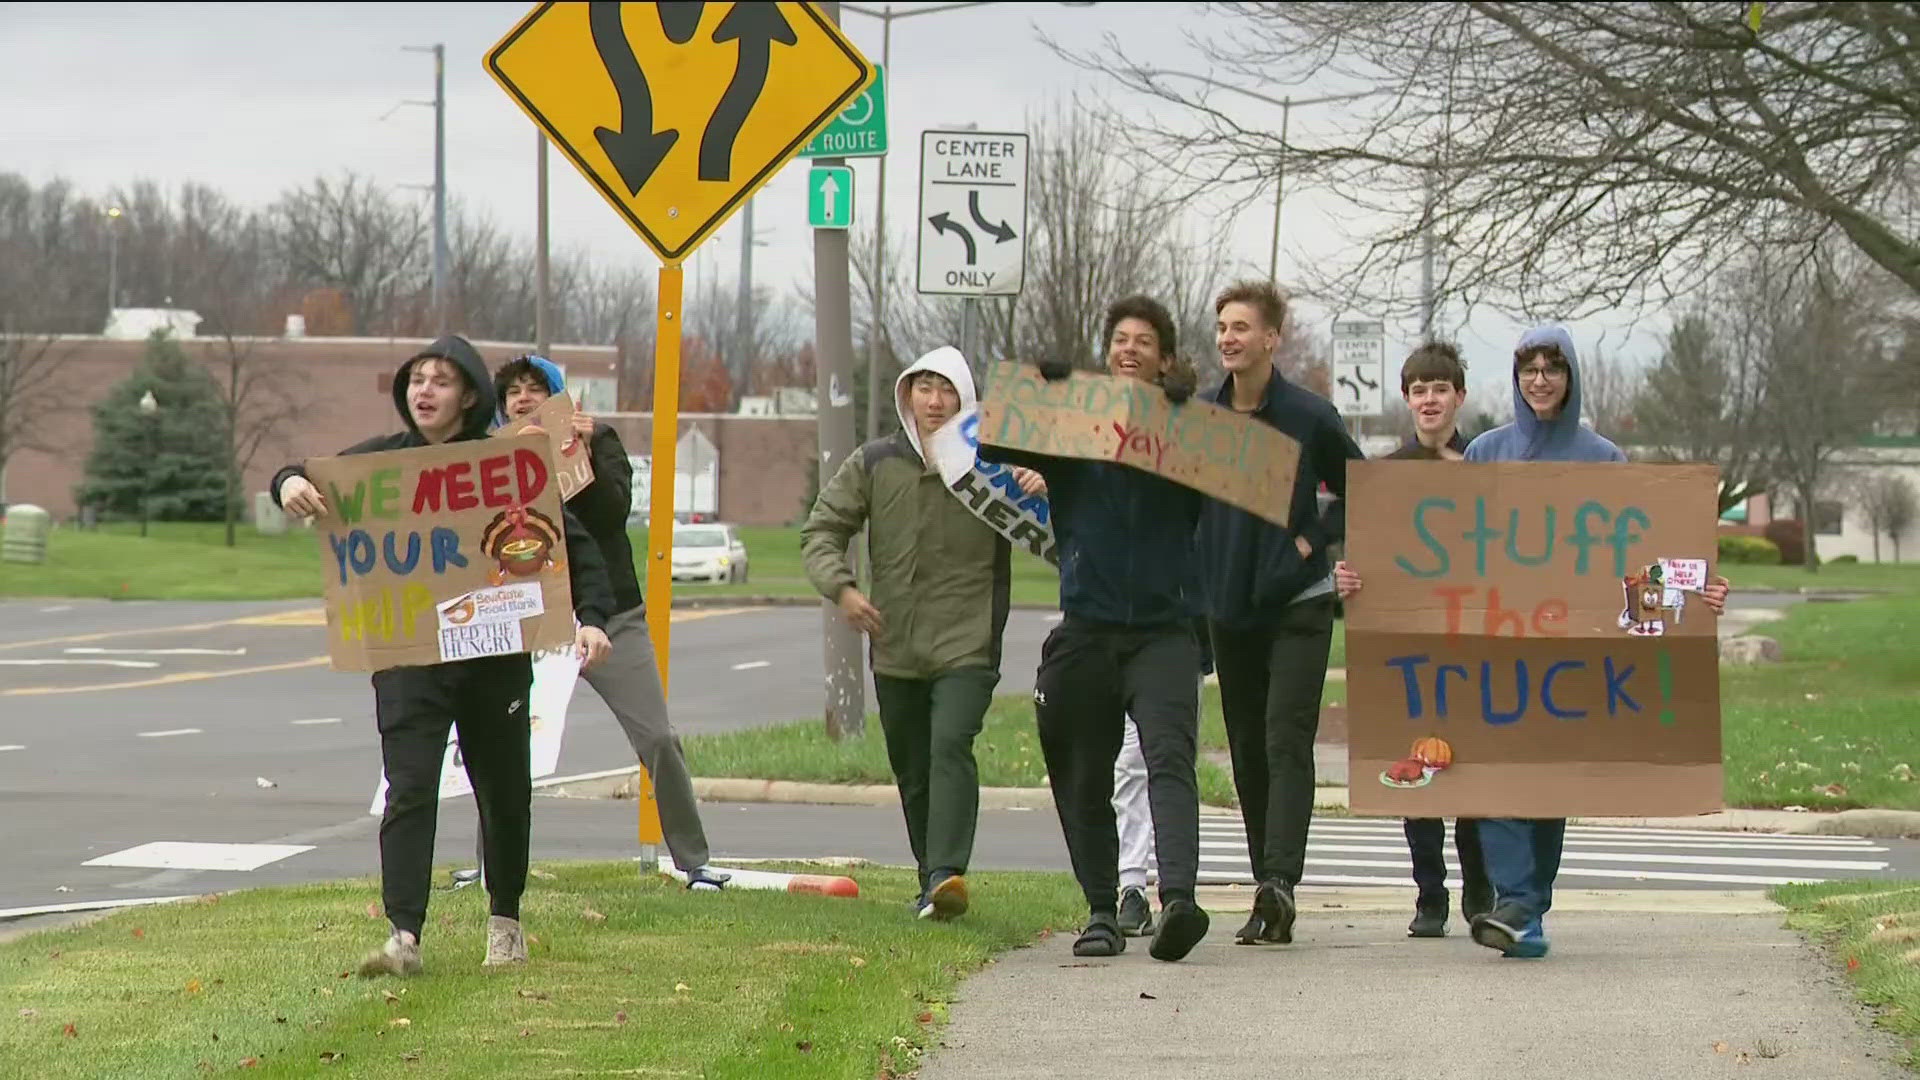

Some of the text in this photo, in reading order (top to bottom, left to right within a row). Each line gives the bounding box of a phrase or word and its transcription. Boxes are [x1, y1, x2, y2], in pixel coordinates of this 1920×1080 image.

[824, 131, 877, 152] ROUTE
[935, 140, 1015, 158] CENTER
[946, 161, 1002, 178] LANE
[945, 271, 996, 287] ONLY
[330, 448, 548, 526] WE NEED
[329, 526, 469, 587] YOUR
[1432, 585, 1569, 648] The
[442, 621, 512, 644] FEED THE
[443, 637, 513, 659] HUNGRY
